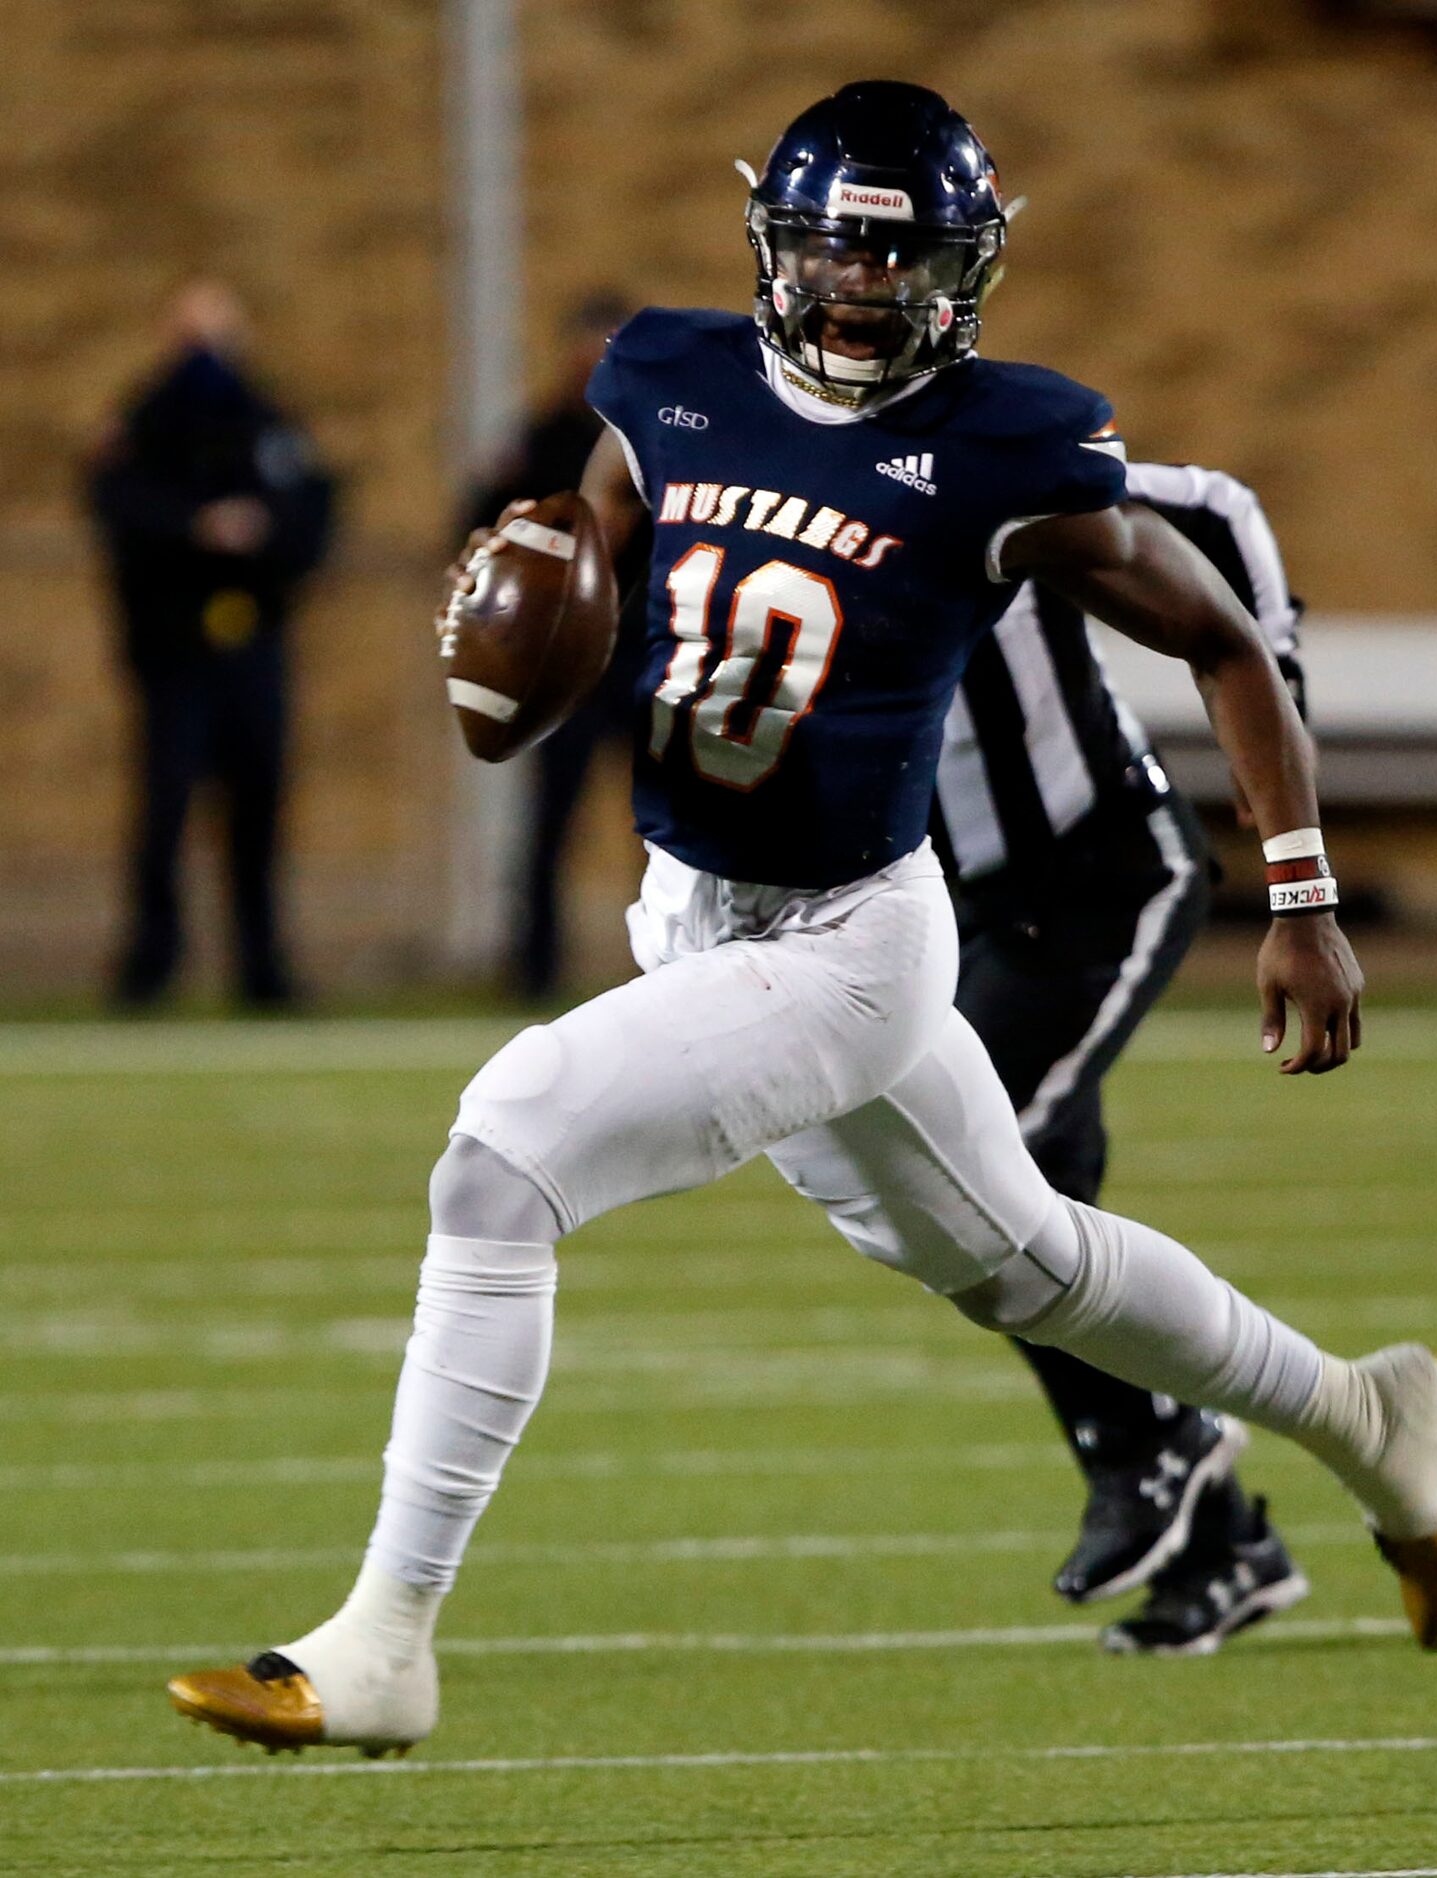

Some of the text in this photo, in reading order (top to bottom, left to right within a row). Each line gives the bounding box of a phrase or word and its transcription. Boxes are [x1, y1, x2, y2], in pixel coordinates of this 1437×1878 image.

[841, 190, 904, 209] Riddell
[658, 395, 709, 430] GISD
[876, 461, 937, 496] adidas
[657, 482, 904, 570] MUSTANGS
[648, 542, 845, 794] 10
